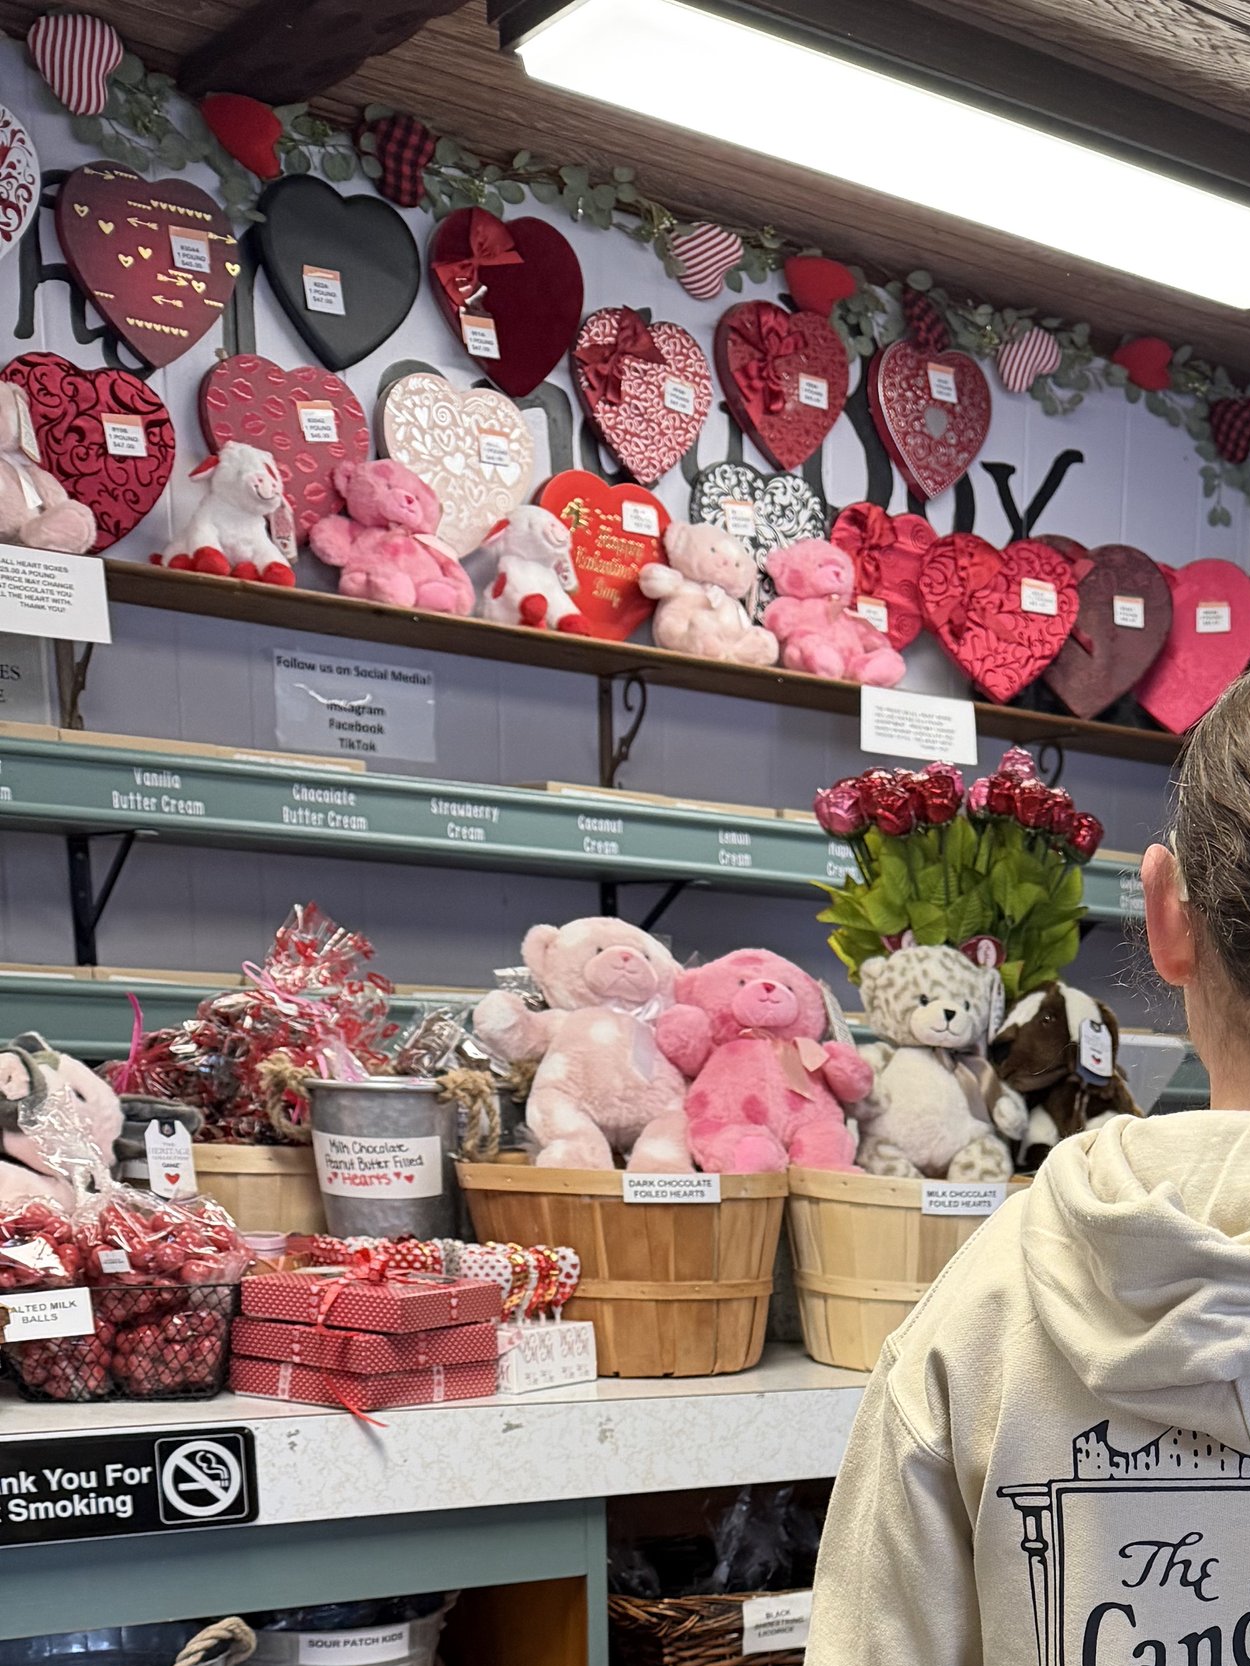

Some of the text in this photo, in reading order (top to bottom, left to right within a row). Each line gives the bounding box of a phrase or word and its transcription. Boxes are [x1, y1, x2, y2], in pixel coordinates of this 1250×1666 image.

[276, 656, 316, 671] Follow
[320, 664, 334, 674] us
[336, 666, 350, 675] on
[354, 666, 388, 680] Social
[328, 718, 384, 734] Facebook
[338, 738, 376, 752] TikTok
[134, 767, 182, 789] Vanilla
[112, 790, 205, 816] Butter Cream
[292, 784, 356, 806] Chocolate
[282, 806, 368, 830] Butter Cream
[430, 798, 500, 823] Strawberry
[447, 822, 486, 841] Cream
[577, 814, 624, 834] Coconut
[582, 836, 619, 855] Cream
[718, 830, 751, 846] Lemon
[718, 849, 752, 866] Cream
[328, 1139, 409, 1154] Milk Chocolate
[324, 1154, 424, 1171] Peanut Butter Filled
[341, 1172, 392, 1186] Hearts
[628, 1179, 712, 1188] DARK CHOCOLATE
[670, 1190, 706, 1198] HEARTS
[11, 1300, 78, 1314] ALTED MILK
[22, 1314, 58, 1324] BALLS
[42, 1468, 98, 1492] You
[105, 1464, 153, 1487] For
[8, 1492, 134, 1522] Smoking
[1118, 1532, 1220, 1602] The
[308, 1632, 404, 1648] SOUR PATCH KIDS
